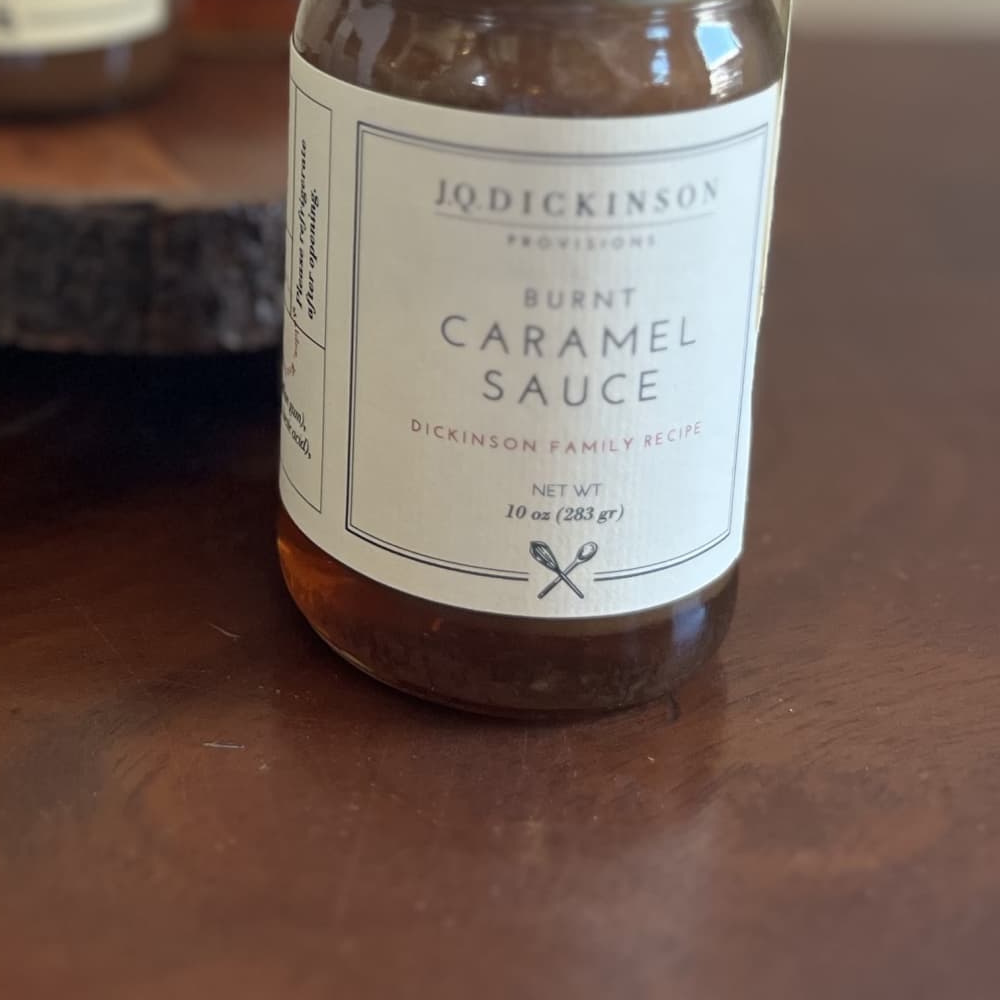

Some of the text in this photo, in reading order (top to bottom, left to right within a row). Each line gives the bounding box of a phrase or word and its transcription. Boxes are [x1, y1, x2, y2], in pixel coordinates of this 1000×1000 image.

[295, 139, 308, 309] Please refrigerate
[507, 232, 657, 251] PROVISIONS
[305, 188, 320, 320] after opening.
[524, 287, 638, 311] BURNT
[440, 314, 698, 359] CARAMEL
[482, 368, 661, 407] SAUCE
[410, 417, 705, 455] DICKINSON FAMILY RECIPE
[531, 482, 605, 499] NET WT
[504, 503, 625, 525] 10 oz (283 gr)
